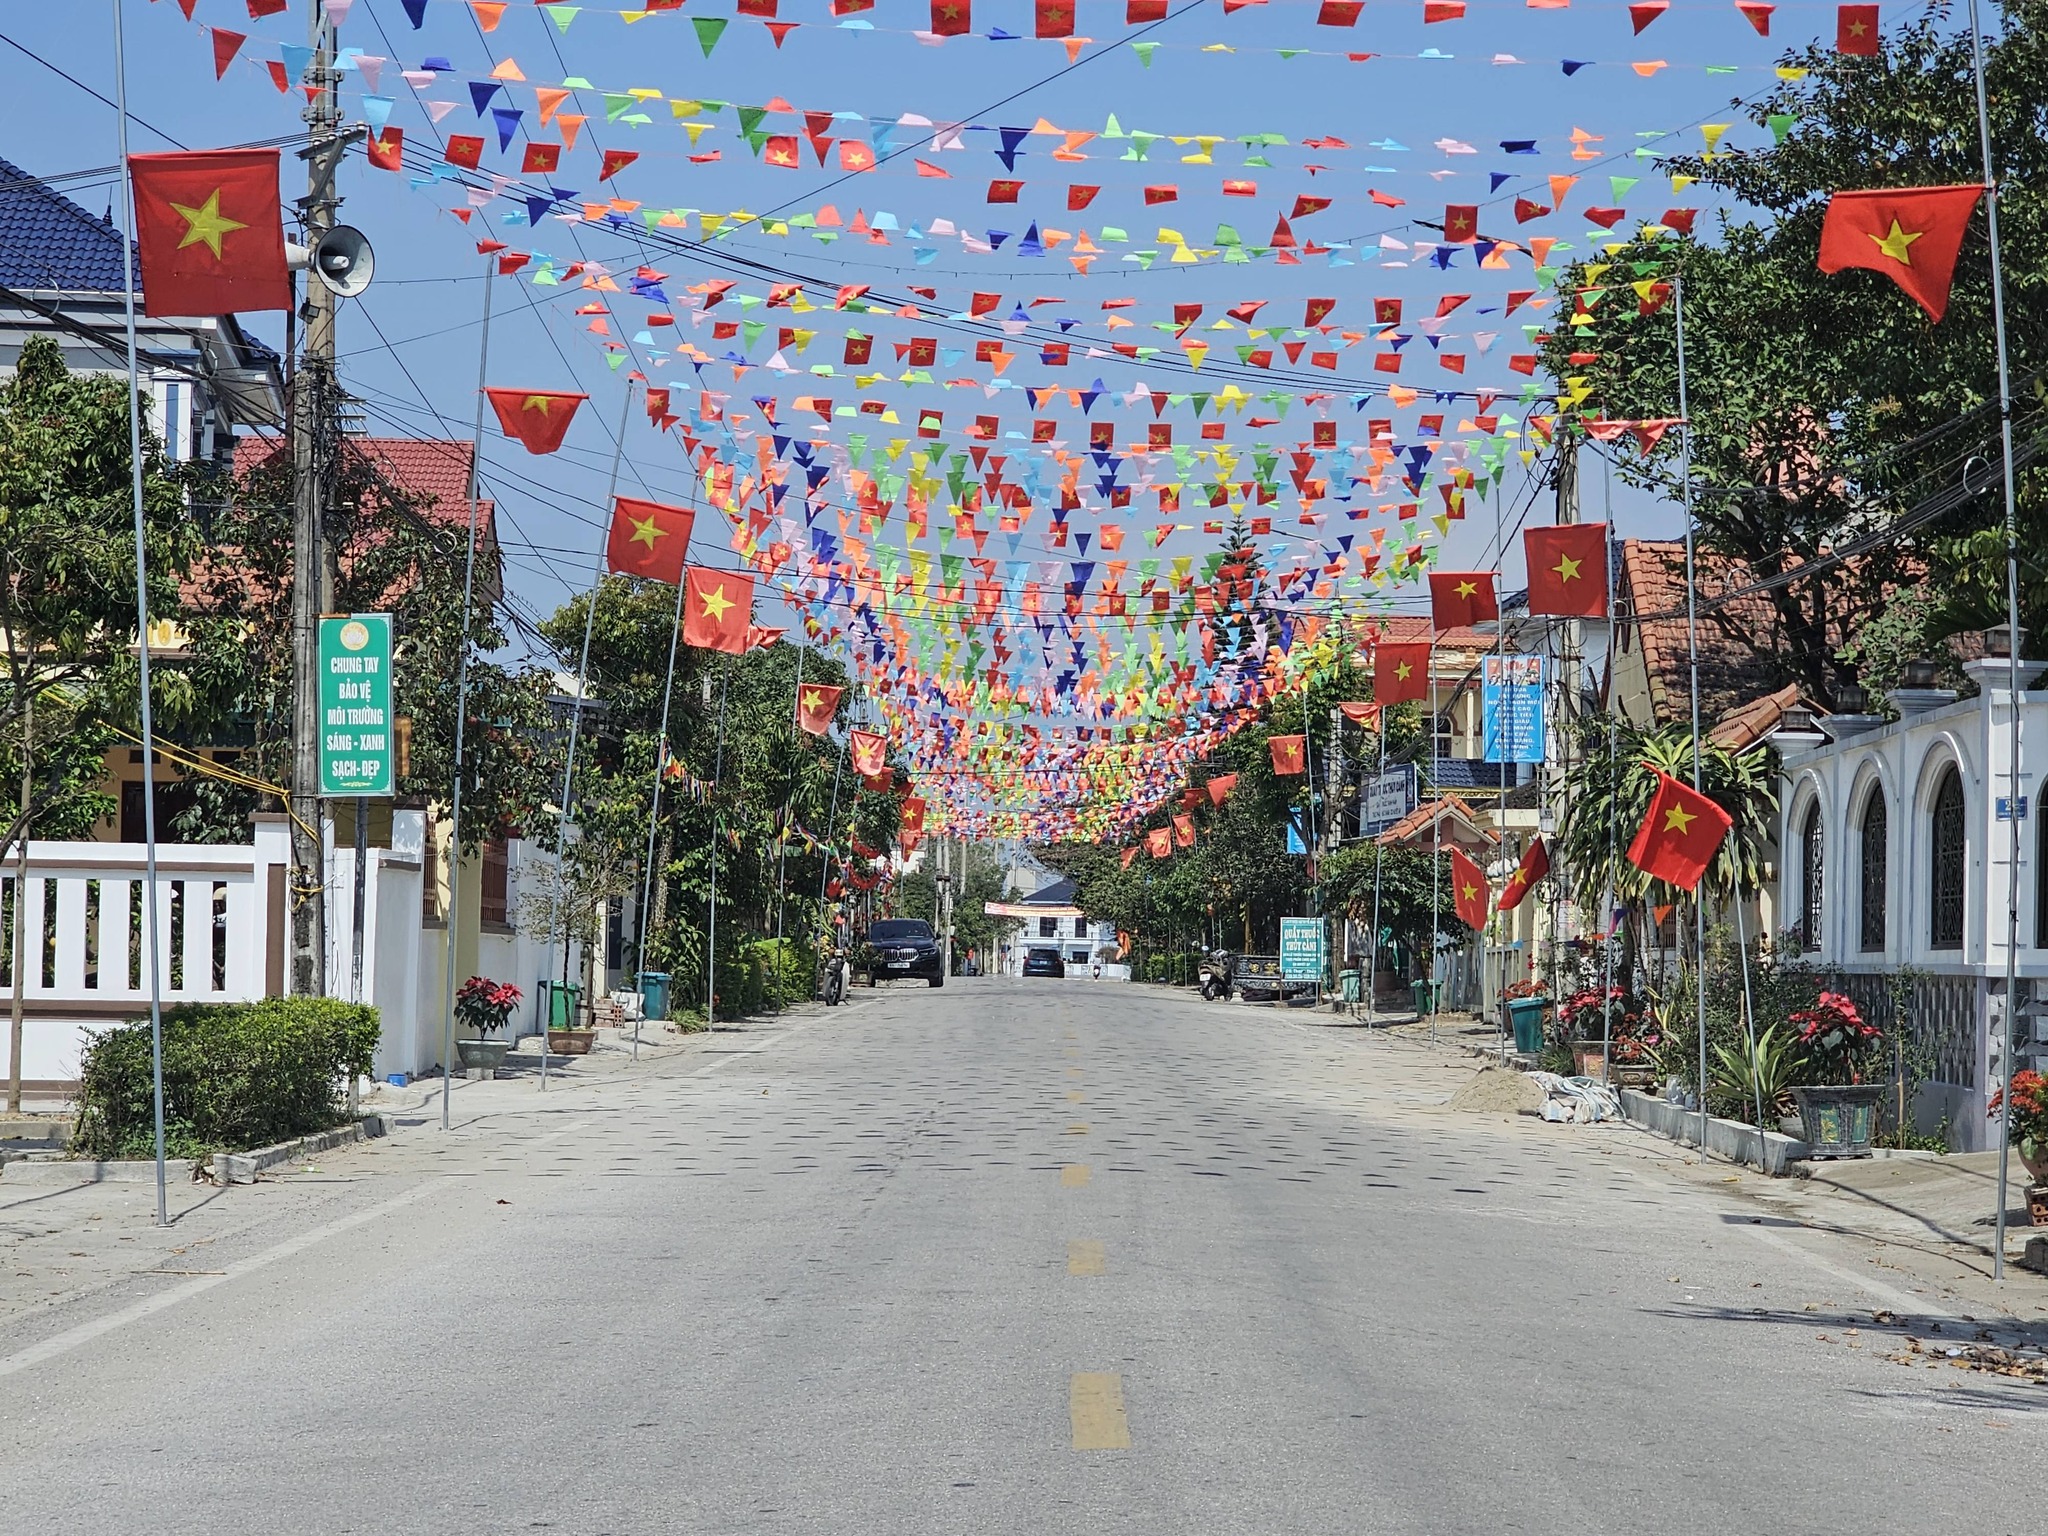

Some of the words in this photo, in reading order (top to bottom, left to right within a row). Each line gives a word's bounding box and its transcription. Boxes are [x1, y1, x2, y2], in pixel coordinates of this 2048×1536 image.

[330, 656, 363, 674] CHUNG
[363, 656, 380, 674] TAY
[338, 677, 358, 699] BẢO
[359, 679, 372, 703] VỆ
[327, 705, 346, 725] MÔI
[347, 704, 384, 725] TRƯỜNG
[326, 731, 352, 751] SÁNG
[360, 734, 385, 751] XANH
